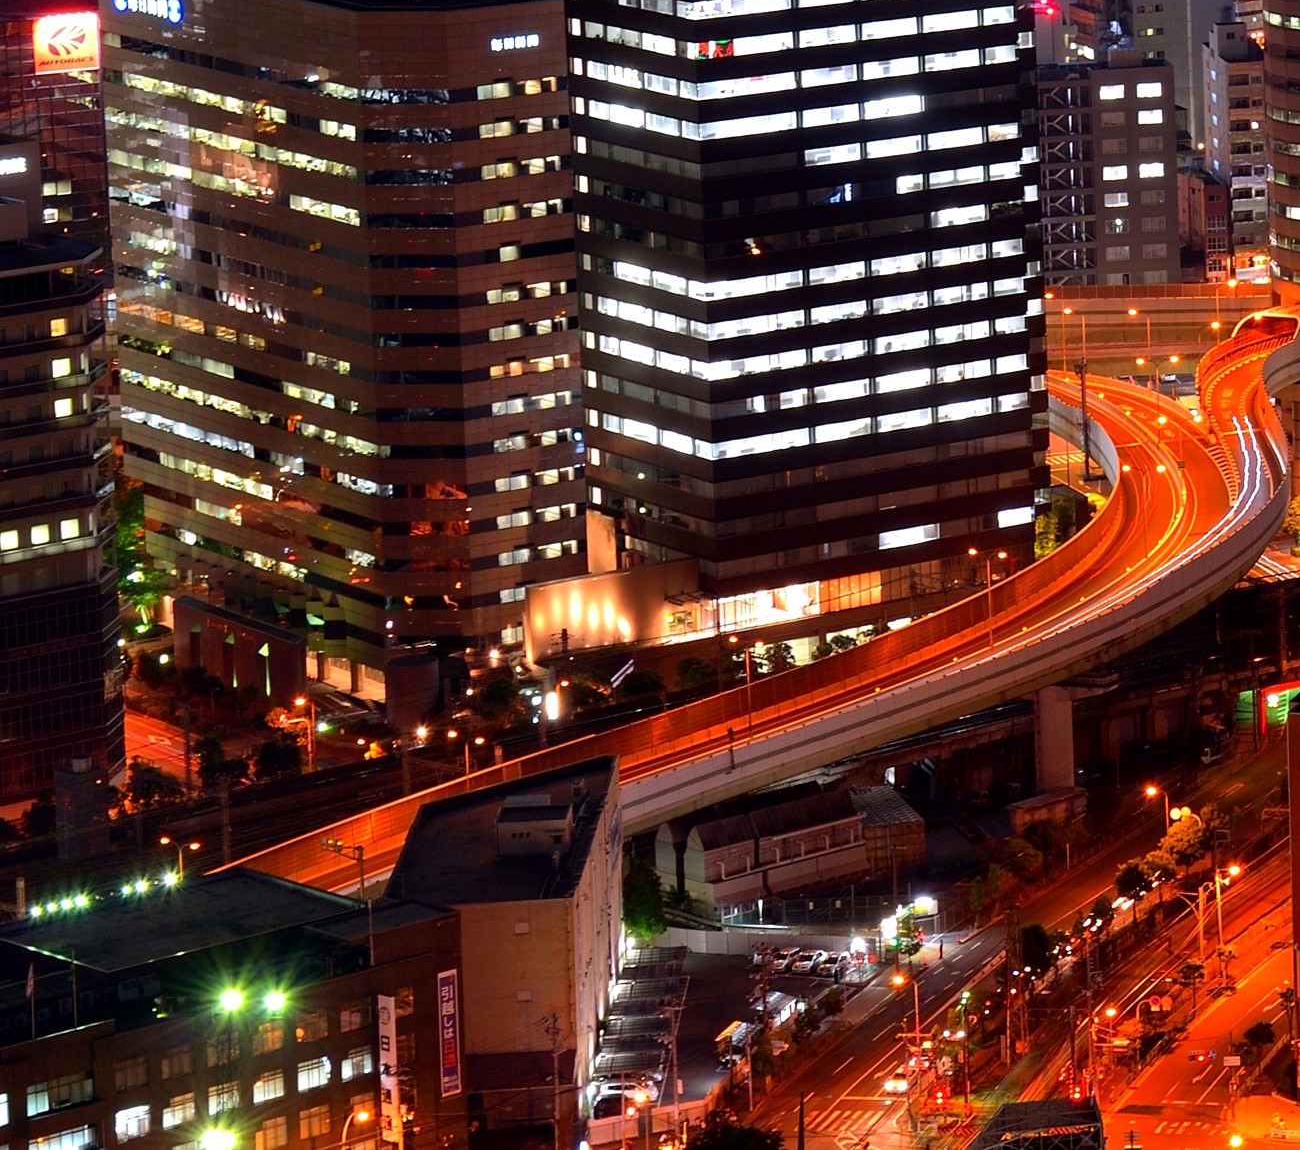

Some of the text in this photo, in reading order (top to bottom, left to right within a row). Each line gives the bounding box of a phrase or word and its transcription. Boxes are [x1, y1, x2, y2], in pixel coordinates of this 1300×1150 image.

[38, 56, 95, 67] AUTOBACS
[441, 984, 456, 1068] 引越しは日通
